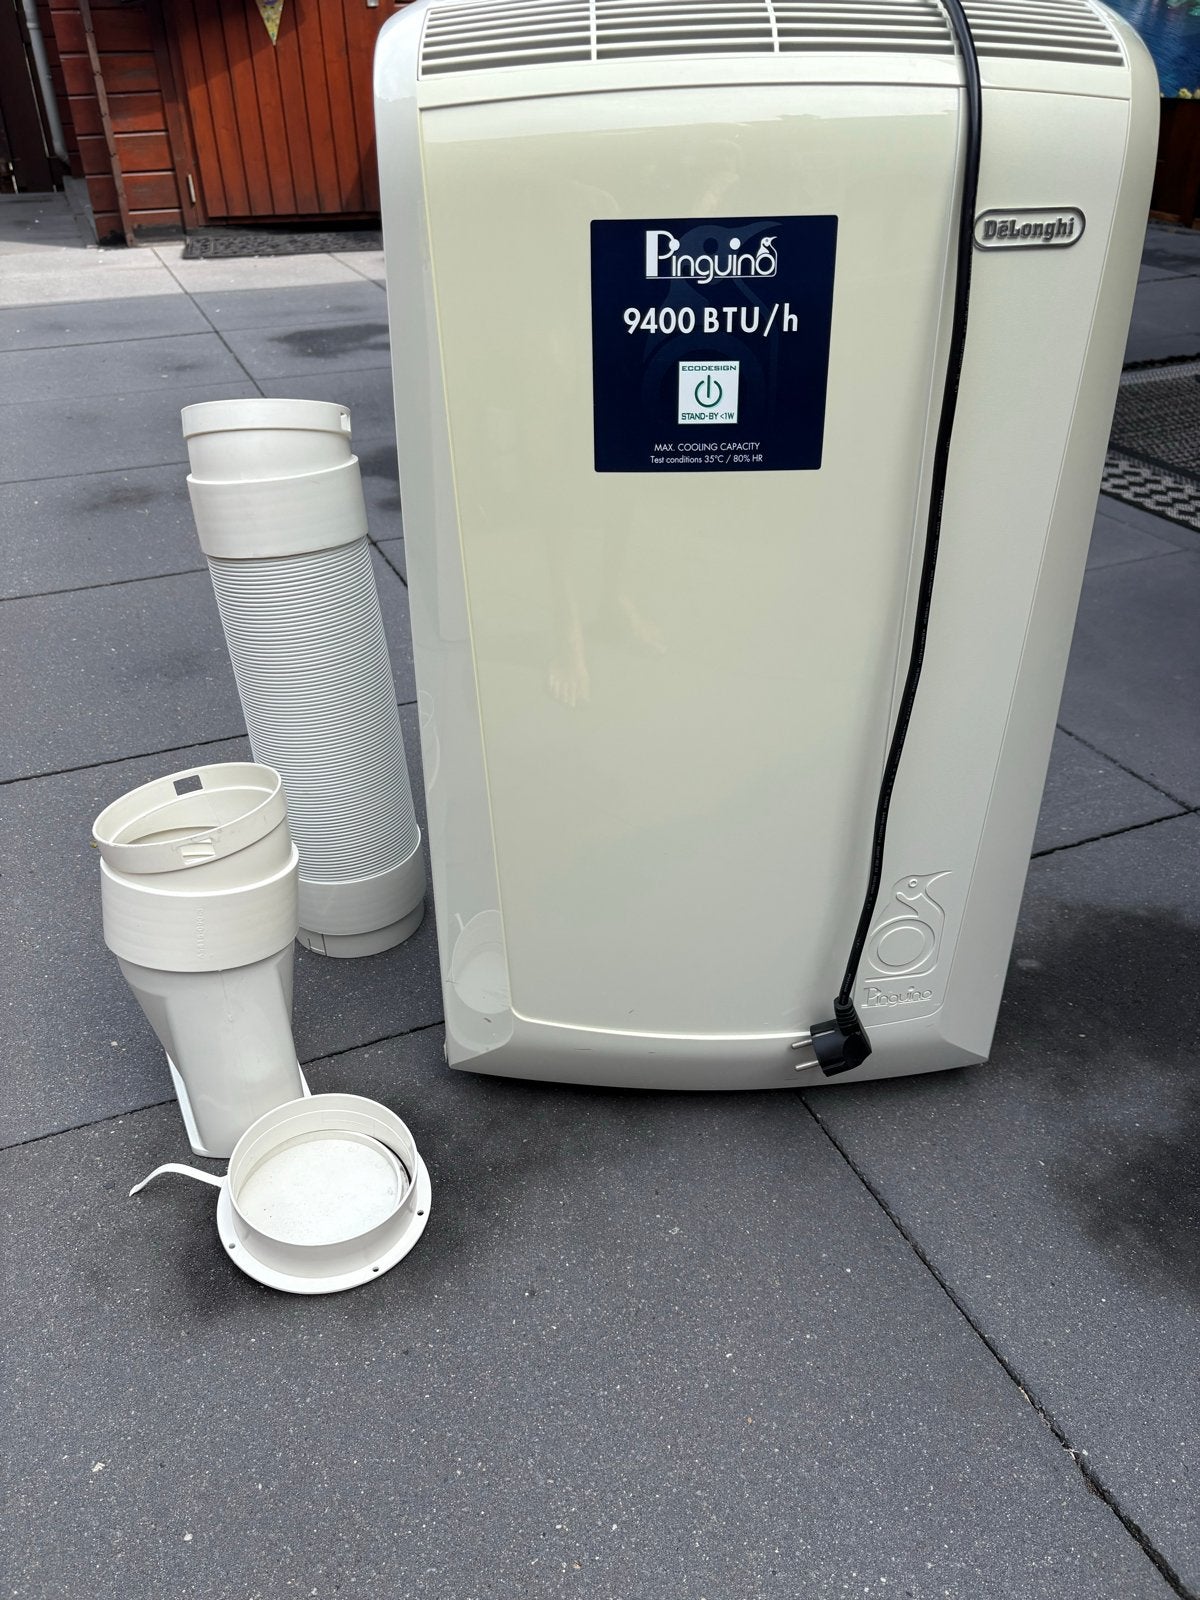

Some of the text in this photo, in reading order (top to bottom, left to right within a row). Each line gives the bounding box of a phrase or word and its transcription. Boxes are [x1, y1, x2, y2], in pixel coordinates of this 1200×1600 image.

[645, 230, 778, 284] Pinguino
[623, 306, 696, 334] 9400
[681, 412, 719, 420] STAND-BY
[654, 442, 760, 452] MAX. COOLING CAPACITY
[650, 455, 664, 464] Test
[665, 455, 702, 464] conditions
[733, 454, 751, 463] 80%
[752, 453, 763, 462] HR
[861, 985, 933, 1008] Pinguino
